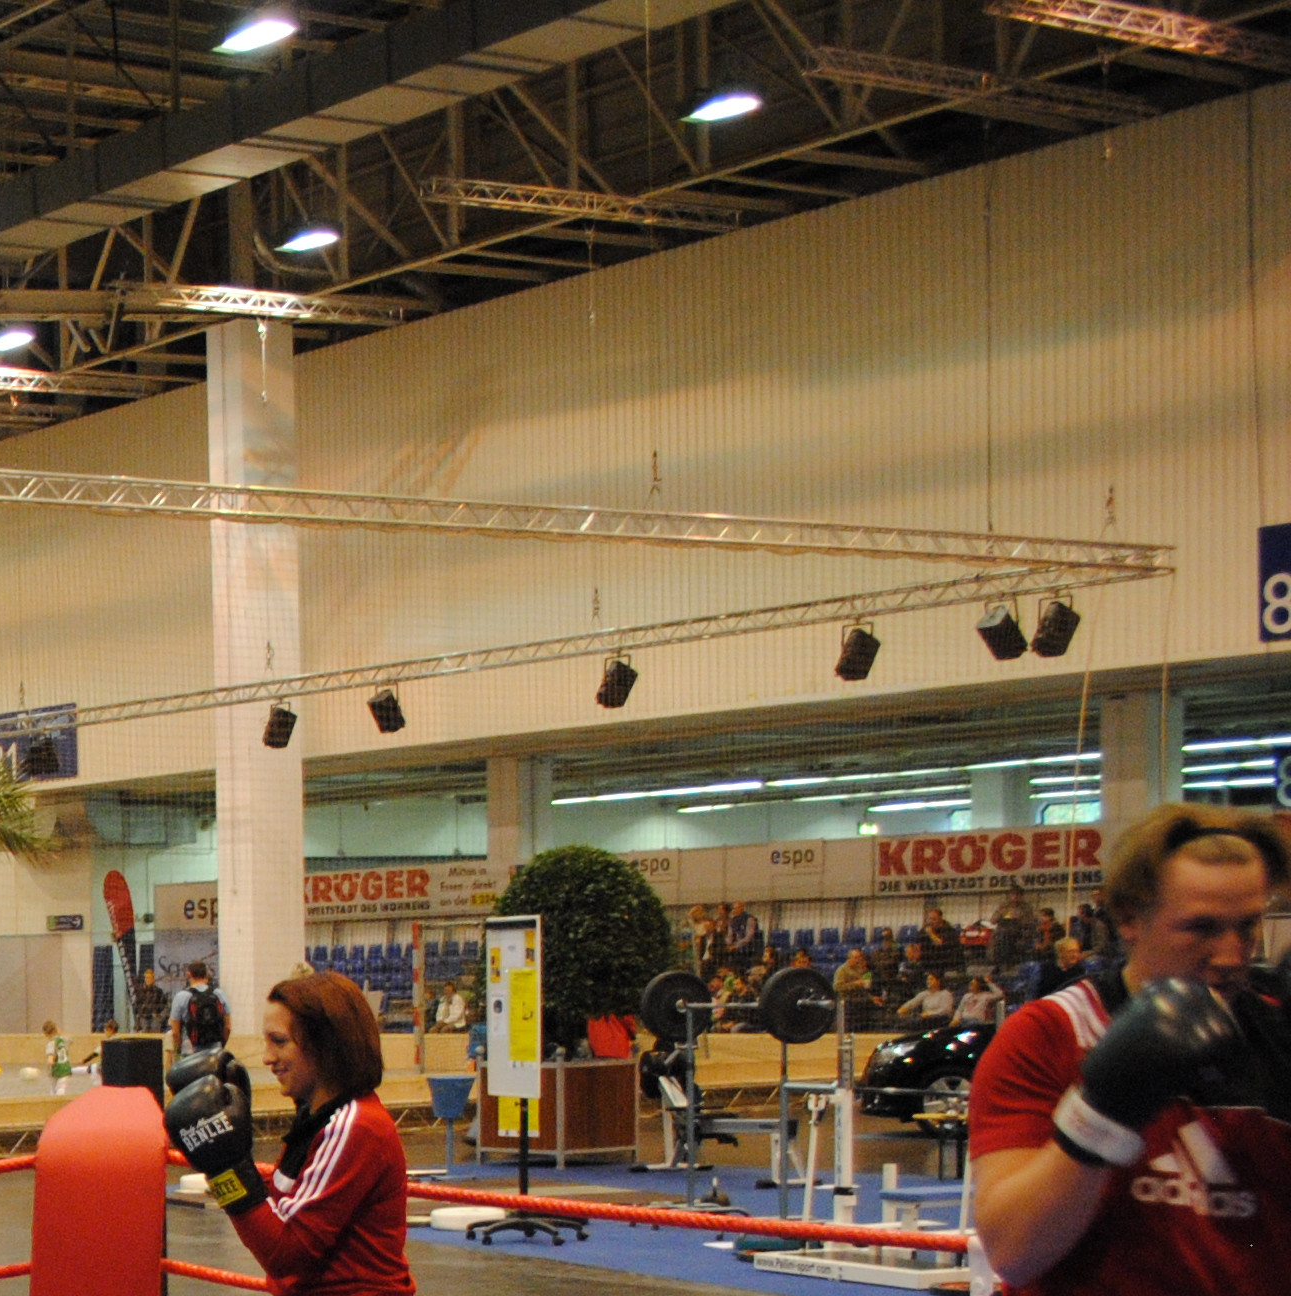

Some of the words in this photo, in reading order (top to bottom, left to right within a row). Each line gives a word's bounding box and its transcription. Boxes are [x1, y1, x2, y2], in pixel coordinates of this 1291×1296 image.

[771, 848, 815, 869] espo
[878, 828, 1103, 877] KRÖGER
[878, 880, 901, 892] DIE
[905, 876, 984, 892] WELTSTADT
[988, 874, 1018, 887] DES
[1021, 869, 1103, 886] WOHNENS
[307, 903, 357, 917] WELTSTADT
[361, 902, 377, 914] DES
[181, 1114, 234, 1152] BENLEE
